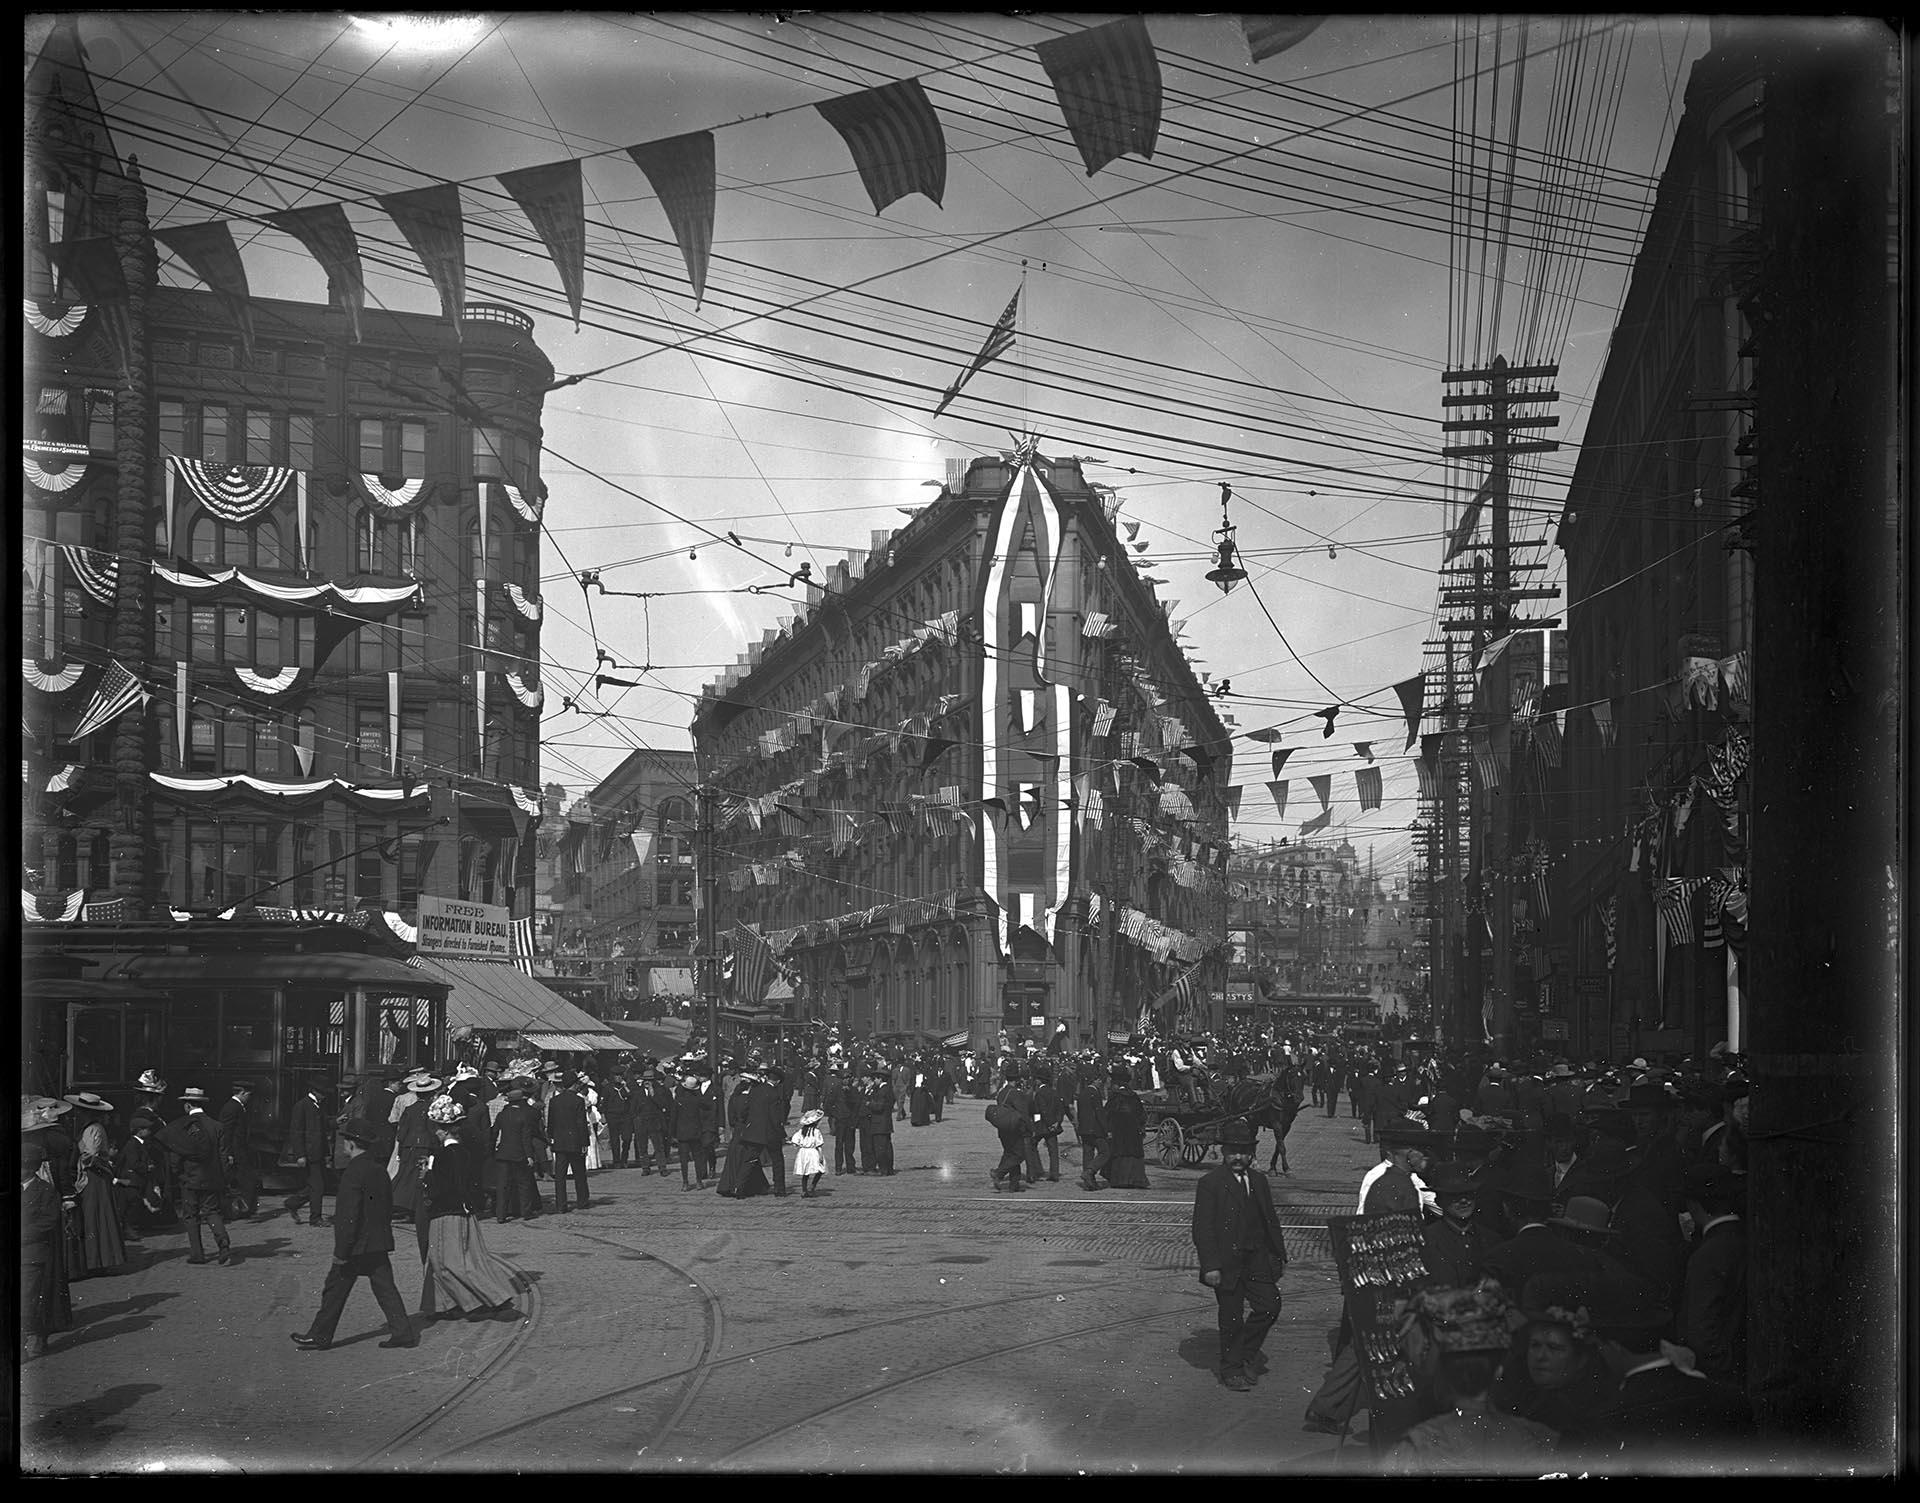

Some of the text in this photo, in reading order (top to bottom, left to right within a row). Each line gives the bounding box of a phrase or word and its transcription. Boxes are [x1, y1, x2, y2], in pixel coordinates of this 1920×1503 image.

[445, 904, 484, 918] FREE
[422, 914, 472, 934] INFORMATION
[421, 933, 442, 950] Strangers
[444, 936, 461, 949] directed
[460, 937, 467, 950] to
[467, 937, 489, 951] Furnished
